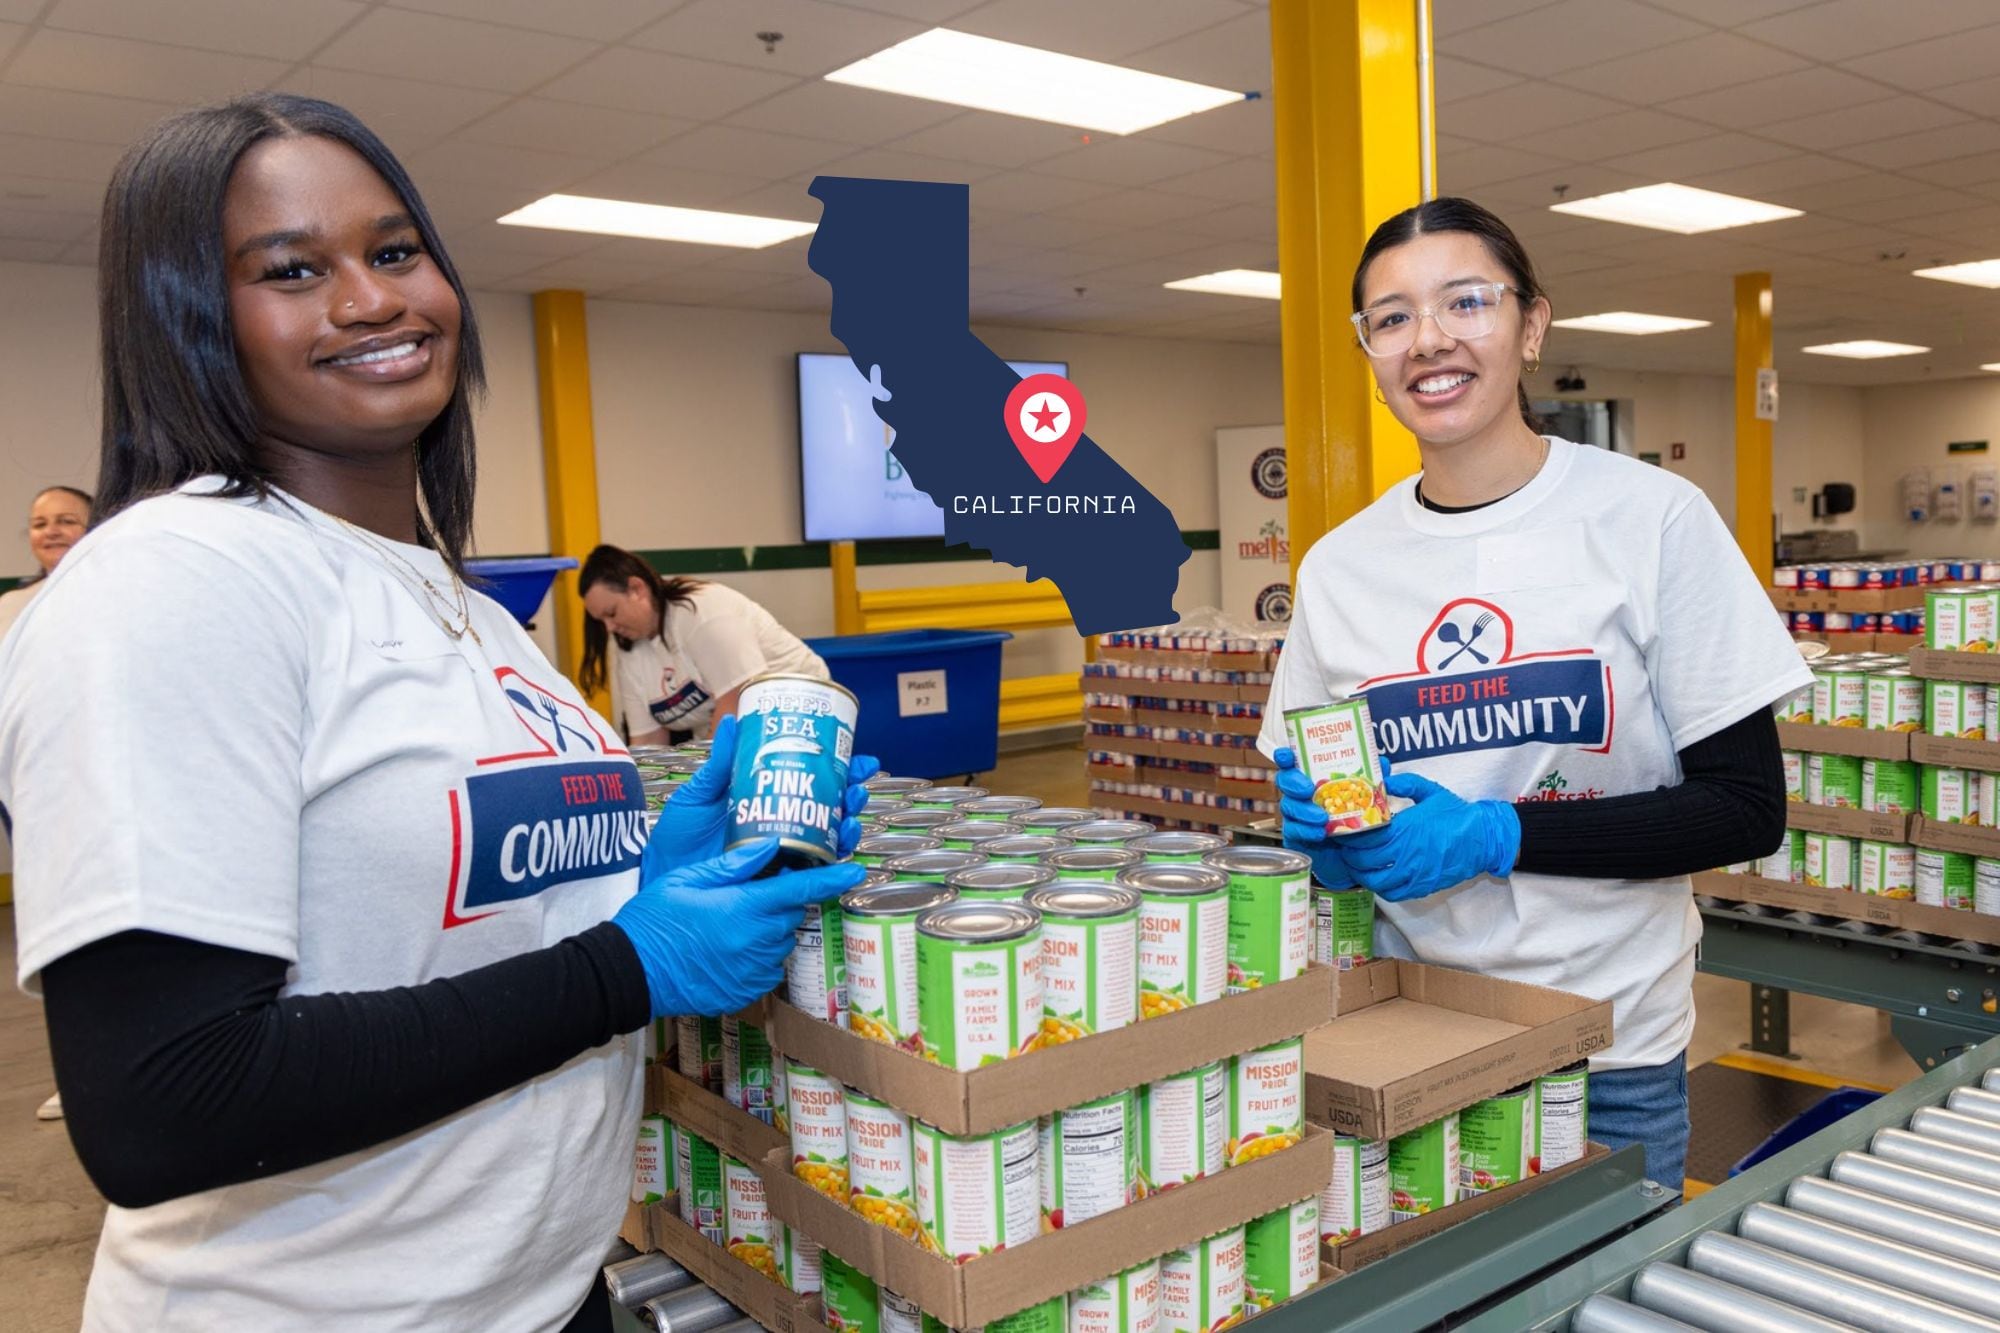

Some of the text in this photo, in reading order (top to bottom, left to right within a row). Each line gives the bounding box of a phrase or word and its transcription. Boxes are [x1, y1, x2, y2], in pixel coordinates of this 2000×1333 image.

[907, 678, 937, 691] Plastic
[1417, 676, 1510, 707] FEED THE
[757, 694, 832, 718] DEEP
[765, 716, 817, 739] SEA
[1306, 720, 1353, 740] MISSION
[1319, 735, 1342, 746] PRIDE
[1312, 747, 1356, 764] FRUIT MIX
[561, 773, 626, 805] FEED THE
[757, 769, 816, 799] PINK
[735, 796, 830, 831] SALMON
[1322, 918, 1332, 927] 70
[809, 936, 823, 945] 70
[1042, 939, 1079, 957] SION
[1156, 954, 1178, 966] MIX
[858, 976, 876, 989] MIX
[1054, 979, 1076, 991] MIX
[963, 988, 998, 998] GROWN
[965, 1005, 997, 1014] FAMILY
[965, 1015, 998, 1025] FARMS
[1575, 1034, 1606, 1054] USDA
[1245, 1059, 1298, 1080] MISSION
[1261, 1078, 1289, 1090] PRIDE
[791, 1087, 843, 1105] MISSION
[1247, 1094, 1297, 1112] FRUIT MIX
[801, 1105, 828, 1116] PRIDE
[1062, 1105, 1123, 1120] Nutrition Facts
[1328, 1107, 1364, 1129] USDA
[794, 1122, 843, 1137] FRUIT MIX
[848, 1116, 902, 1138] MISSION
[858, 1136, 886, 1149] PRIDE
[1063, 1134, 1124, 1153] Calories 70
[851, 1152, 902, 1171] FRUIT MIX
[741, 1193, 767, 1203] PRIDE
[732, 1207, 758, 1221] FRUIT
[1162, 1270, 1191, 1281] GROWN
[1163, 1284, 1190, 1294] FAMILY
[1163, 1293, 1190, 1304] FARMS
[1078, 1309, 1110, 1319] GROWN
[1164, 1308, 1188, 1319] U.S.A.
